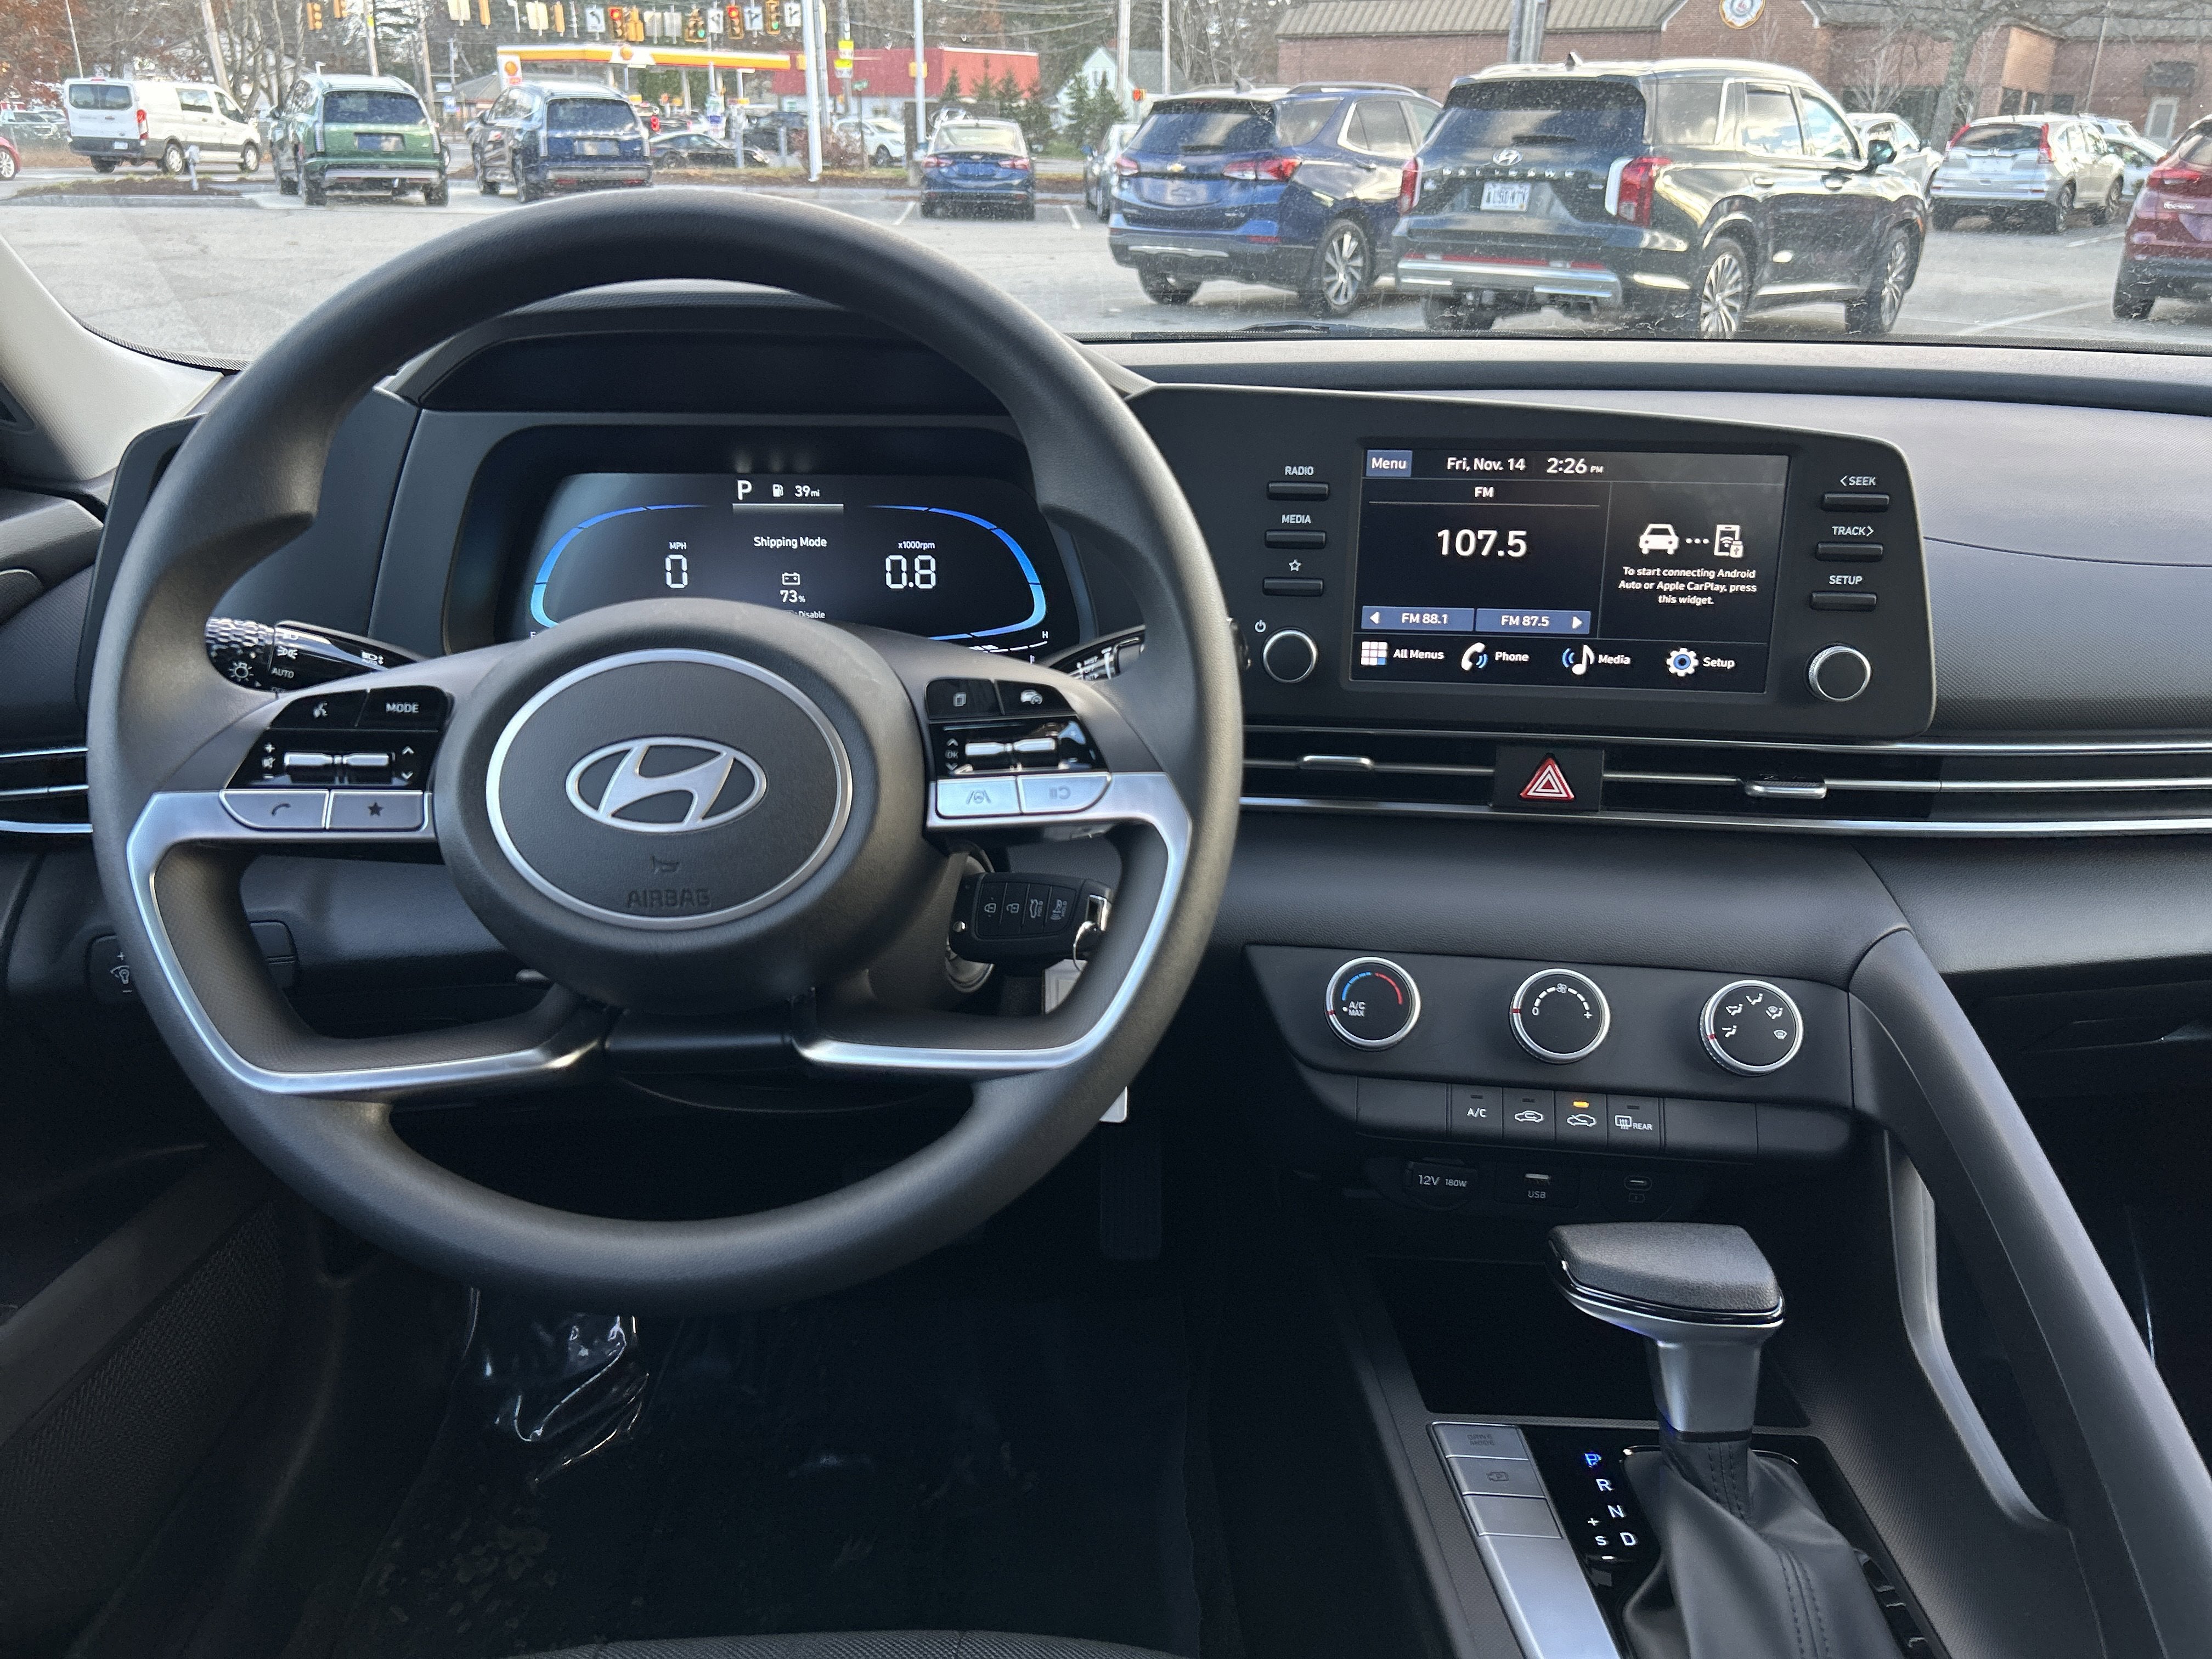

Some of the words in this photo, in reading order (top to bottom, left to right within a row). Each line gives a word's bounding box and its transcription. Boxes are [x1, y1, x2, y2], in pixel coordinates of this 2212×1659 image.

[1372, 457, 1407, 469] Menu
[1447, 457, 1471, 472] Fri,
[1476, 458, 1504, 471] Nov.
[1508, 458, 1526, 471] 14
[1546, 457, 1588, 474] 2:26
[1285, 465, 1314, 476] RADIO
[1848, 476, 1876, 486] SEEK
[737, 479, 752, 500] P
[1474, 487, 1494, 498] FM
[1282, 514, 1312, 524] MEDIA
[1832, 526, 1865, 536] TRACK
[669, 541, 687, 550] MPH
[753, 536, 798, 549] Shipping
[799, 537, 827, 547] Mode
[898, 540, 935, 551] x1000rpm
[1437, 529, 1527, 557] 107.5
[665, 554, 688, 589] 0
[885, 555, 936, 589] 0.8
[1623, 566, 1635, 575] To
[1636, 567, 1661, 576] start
[1662, 568, 1716, 579] connecting
[1717, 568, 1756, 578] Android
[1829, 575, 1863, 585] SETUP
[1618, 580, 1643, 590] Auto
[1643, 582, 1655, 590] or
[1656, 581, 1686, 592] Apple
[1729, 584, 1758, 594] press
[1658, 594, 1678, 604] this
[1678, 595, 1714, 607] widget.
[798, 611, 825, 619] Disable
[1402, 613, 1420, 624] FM
[1422, 613, 1448, 624] 88.1
[1501, 615, 1520, 626] FM
[1522, 615, 1550, 627] 87.5
[1042, 630, 1048, 639] H
[1393, 648, 1408, 659] All
[1409, 648, 1444, 659] Menus
[1494, 651, 1530, 662] Phone
[1598, 654, 1631, 664] Media
[1702, 657, 1735, 669] Setup
[272, 668, 295, 679] AUTO
[386, 703, 419, 713] MODE
[627, 888, 710, 908] AIRBAG
[1349, 1001, 1365, 1009] A/C
[1466, 1108, 1487, 1118] A/C
[1633, 1122, 1652, 1131] REAR
[1418, 1175, 1440, 1186] 12V
[1445, 1178, 1468, 1188] 180W
[1527, 1190, 1547, 1199] USB
[1596, 1479, 1613, 1492] R
[1607, 1505, 1626, 1518] N
[1595, 1536, 1607, 1546] S
[1620, 1532, 1637, 1546] D
